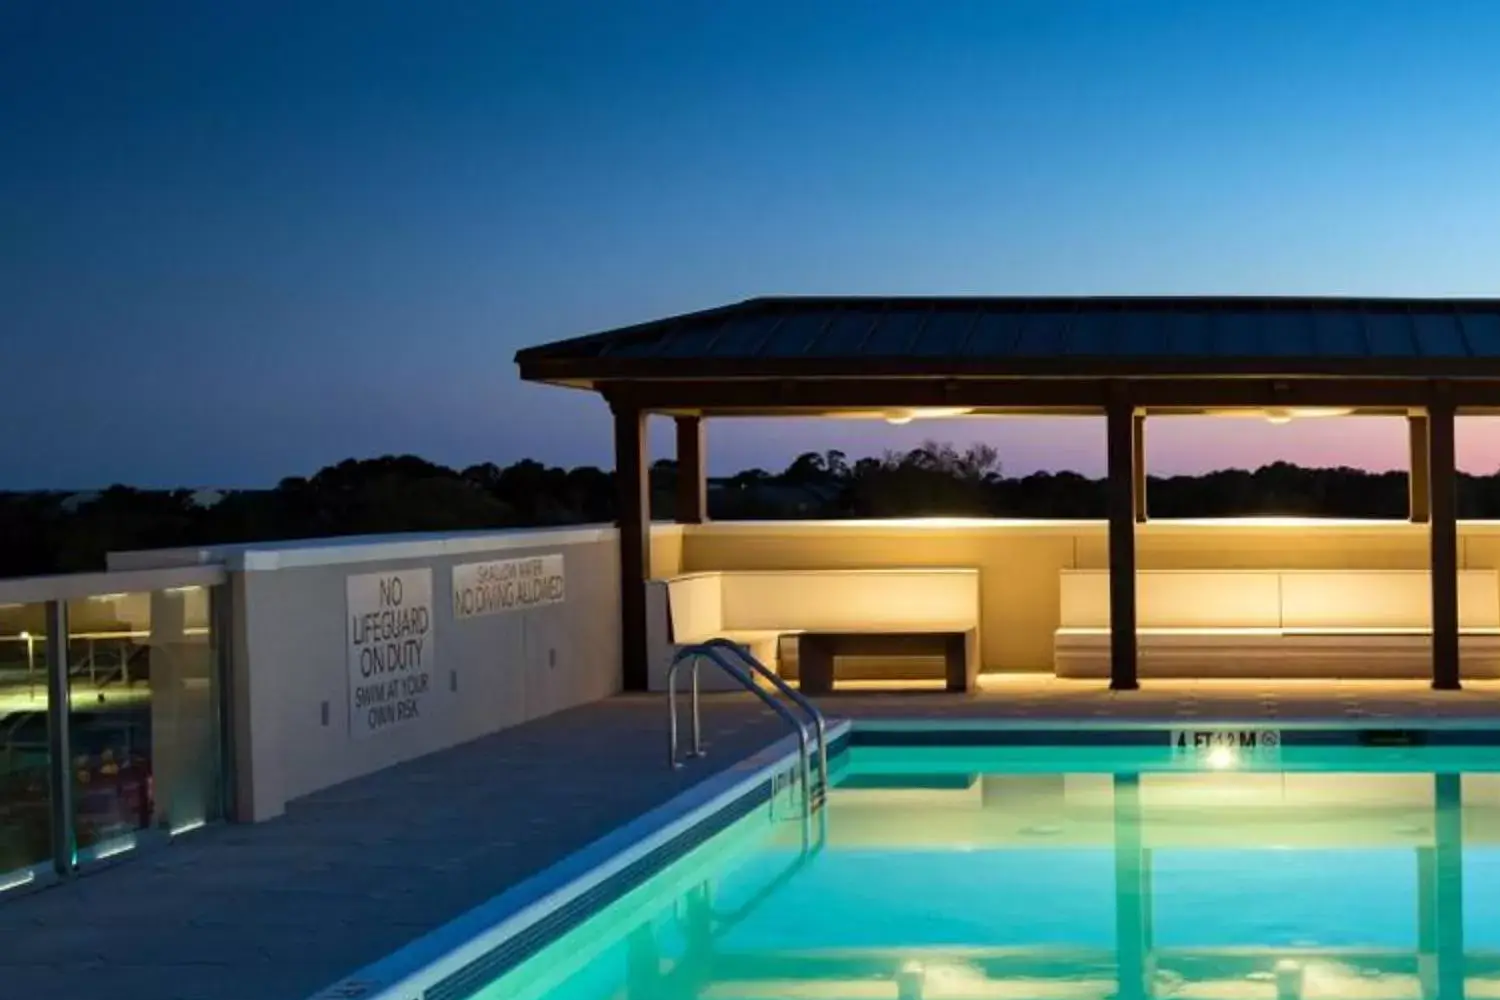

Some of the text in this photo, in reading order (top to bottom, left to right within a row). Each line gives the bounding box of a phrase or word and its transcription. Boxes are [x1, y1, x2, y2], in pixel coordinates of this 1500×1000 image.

[380, 576, 403, 607] NO
[455, 575, 563, 616] NO DIVING ALLOWED
[353, 606, 429, 645] LIFEGUARD
[360, 639, 423, 678] ON DUTY
[355, 674, 429, 708] SWIM AT YOUR
[368, 698, 420, 729] OWN RISK
[1194, 731, 1213, 747] FT
